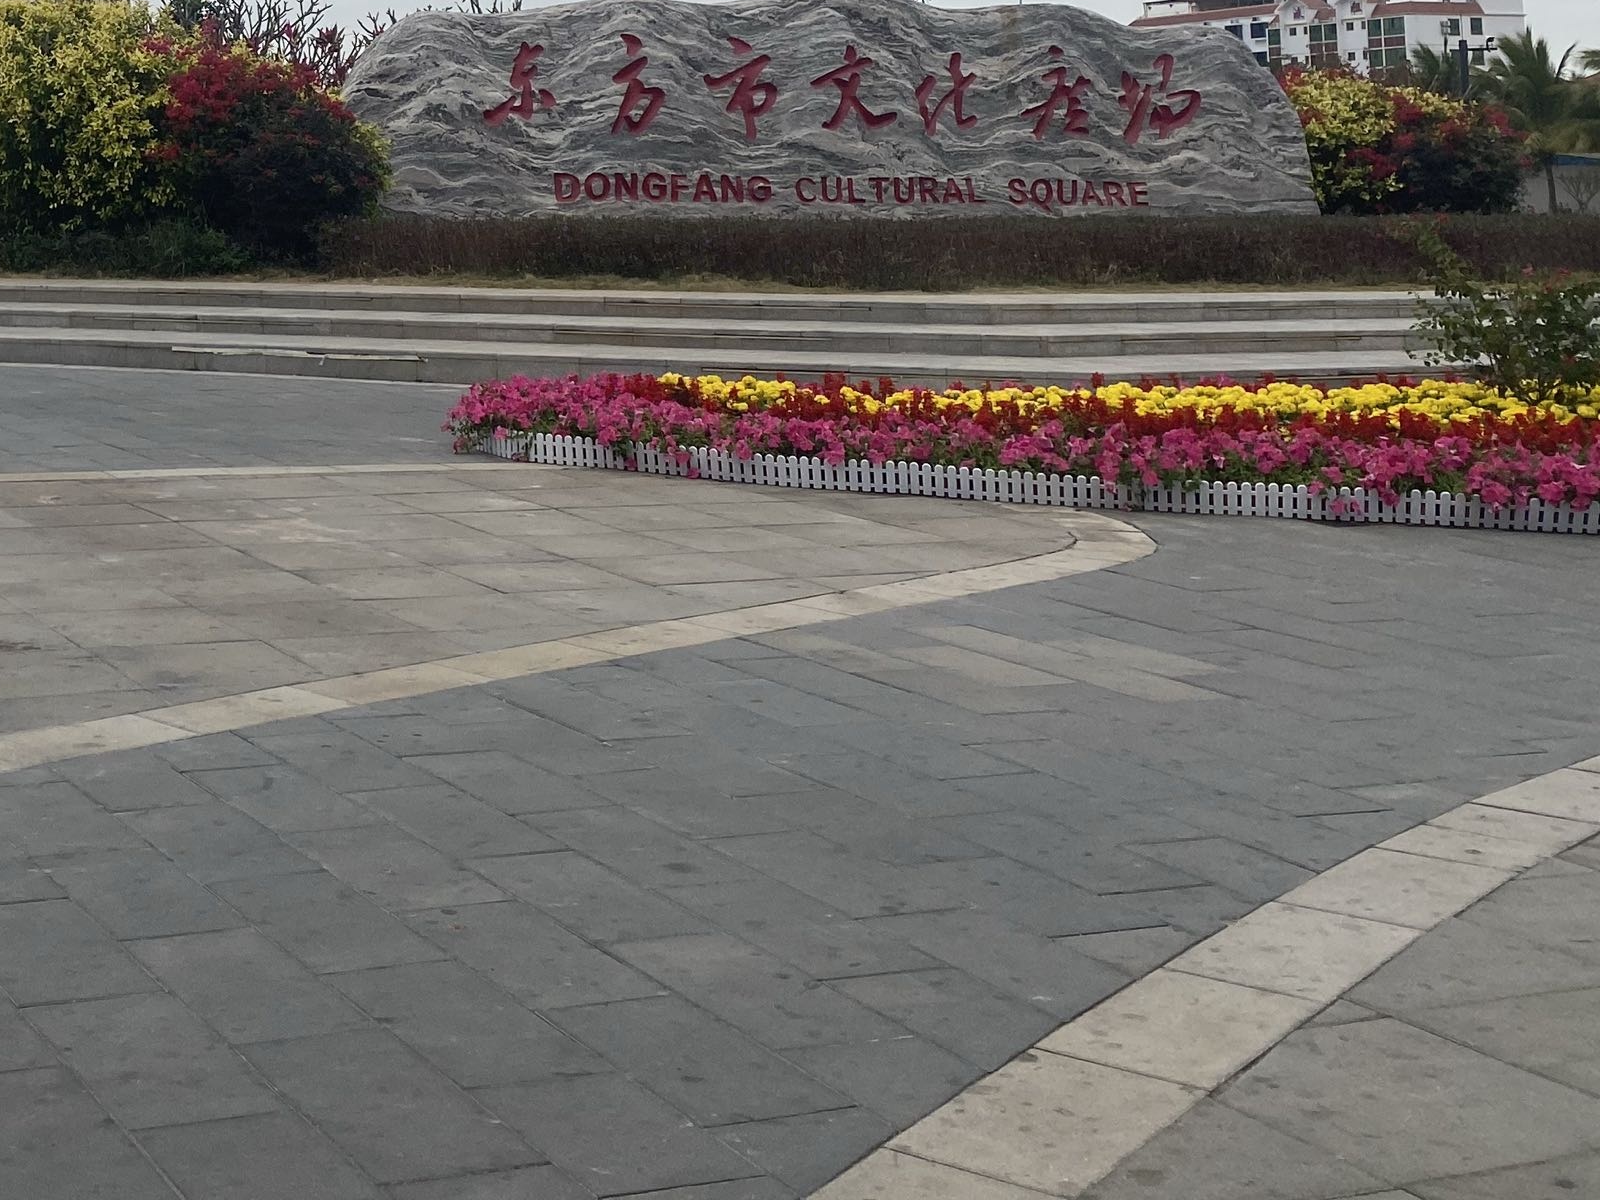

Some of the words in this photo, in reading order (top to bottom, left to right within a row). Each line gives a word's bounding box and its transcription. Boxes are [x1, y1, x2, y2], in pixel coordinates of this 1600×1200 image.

[553, 171, 773, 203] DONGFANG
[794, 175, 986, 205] CULTURAL
[1008, 179, 1150, 211] SQUARE
